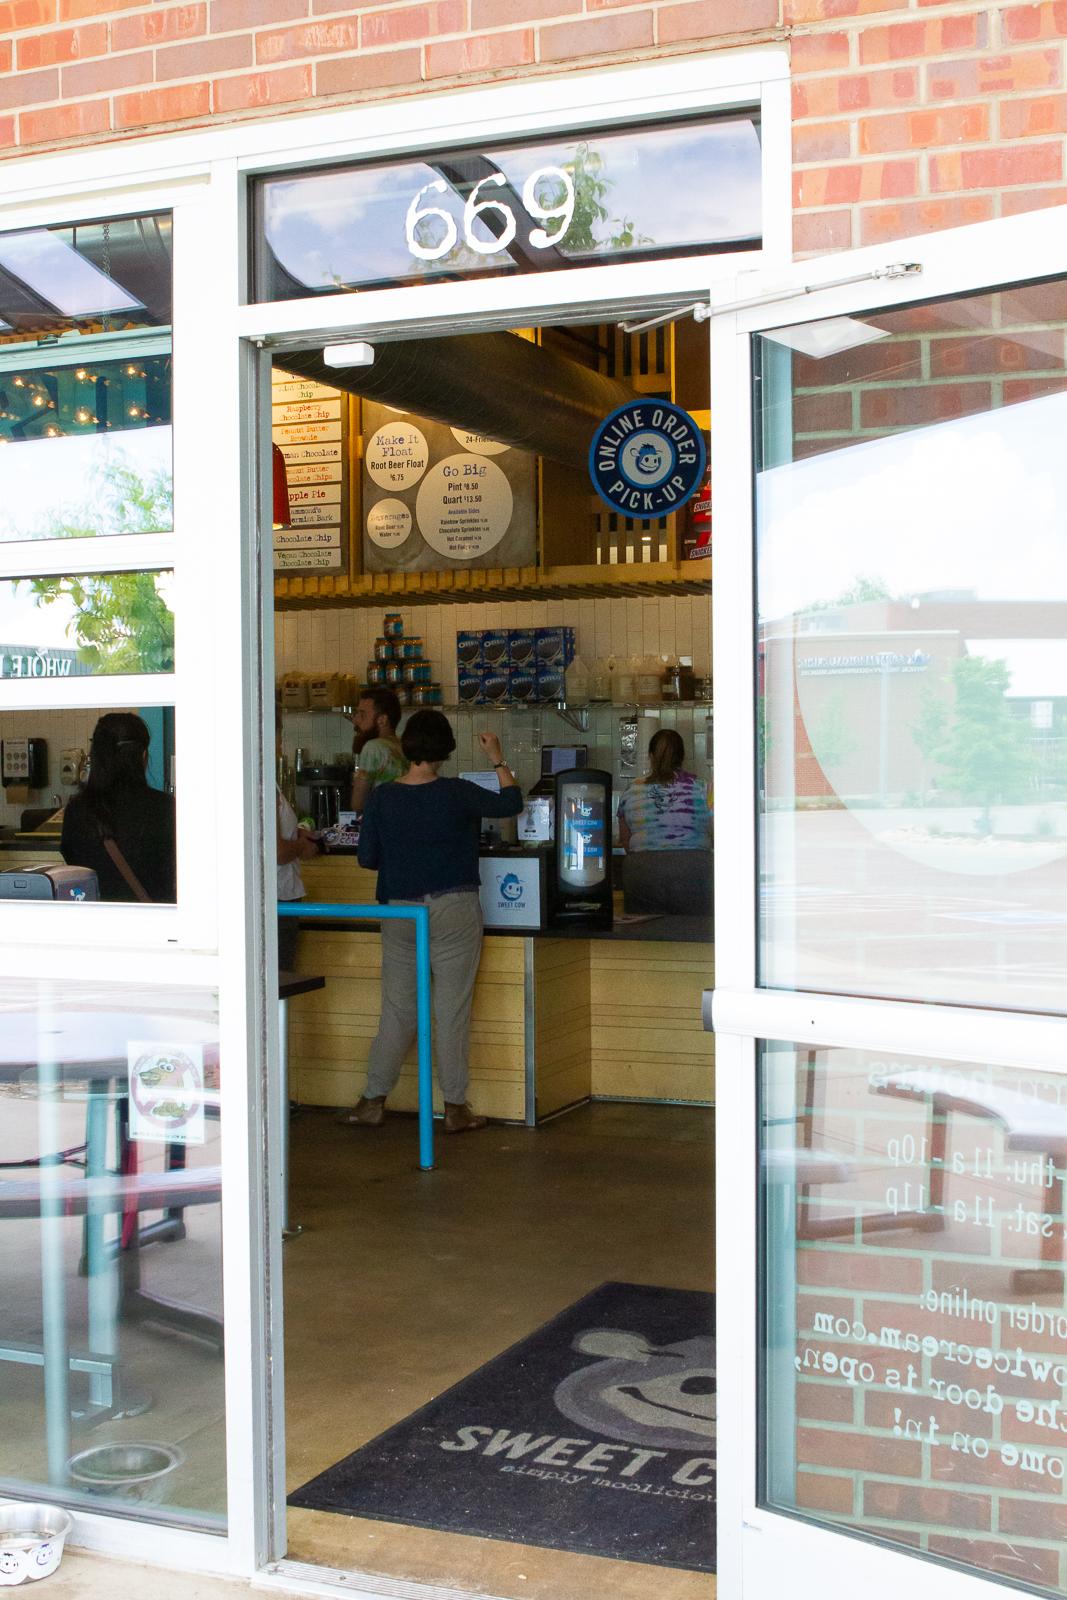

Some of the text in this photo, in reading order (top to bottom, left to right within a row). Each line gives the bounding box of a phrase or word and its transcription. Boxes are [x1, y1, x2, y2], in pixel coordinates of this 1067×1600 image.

[405, 166, 576, 260] 669
[376, 434, 420, 447] Make It
[598, 409, 697, 472] ONLINE ORDER
[382, 446, 413, 457] Float
[370, 458, 424, 470] Root Beer Float
[442, 463, 487, 478] Go Big
[311, 489, 326, 498] Pie
[448, 483, 462, 492] Pint
[608, 475, 687, 510] PICK-UP
[442, 496, 463, 505] Quart
[440, 1425, 668, 1477] SWEET
[500, 1464, 587, 1485] simply
